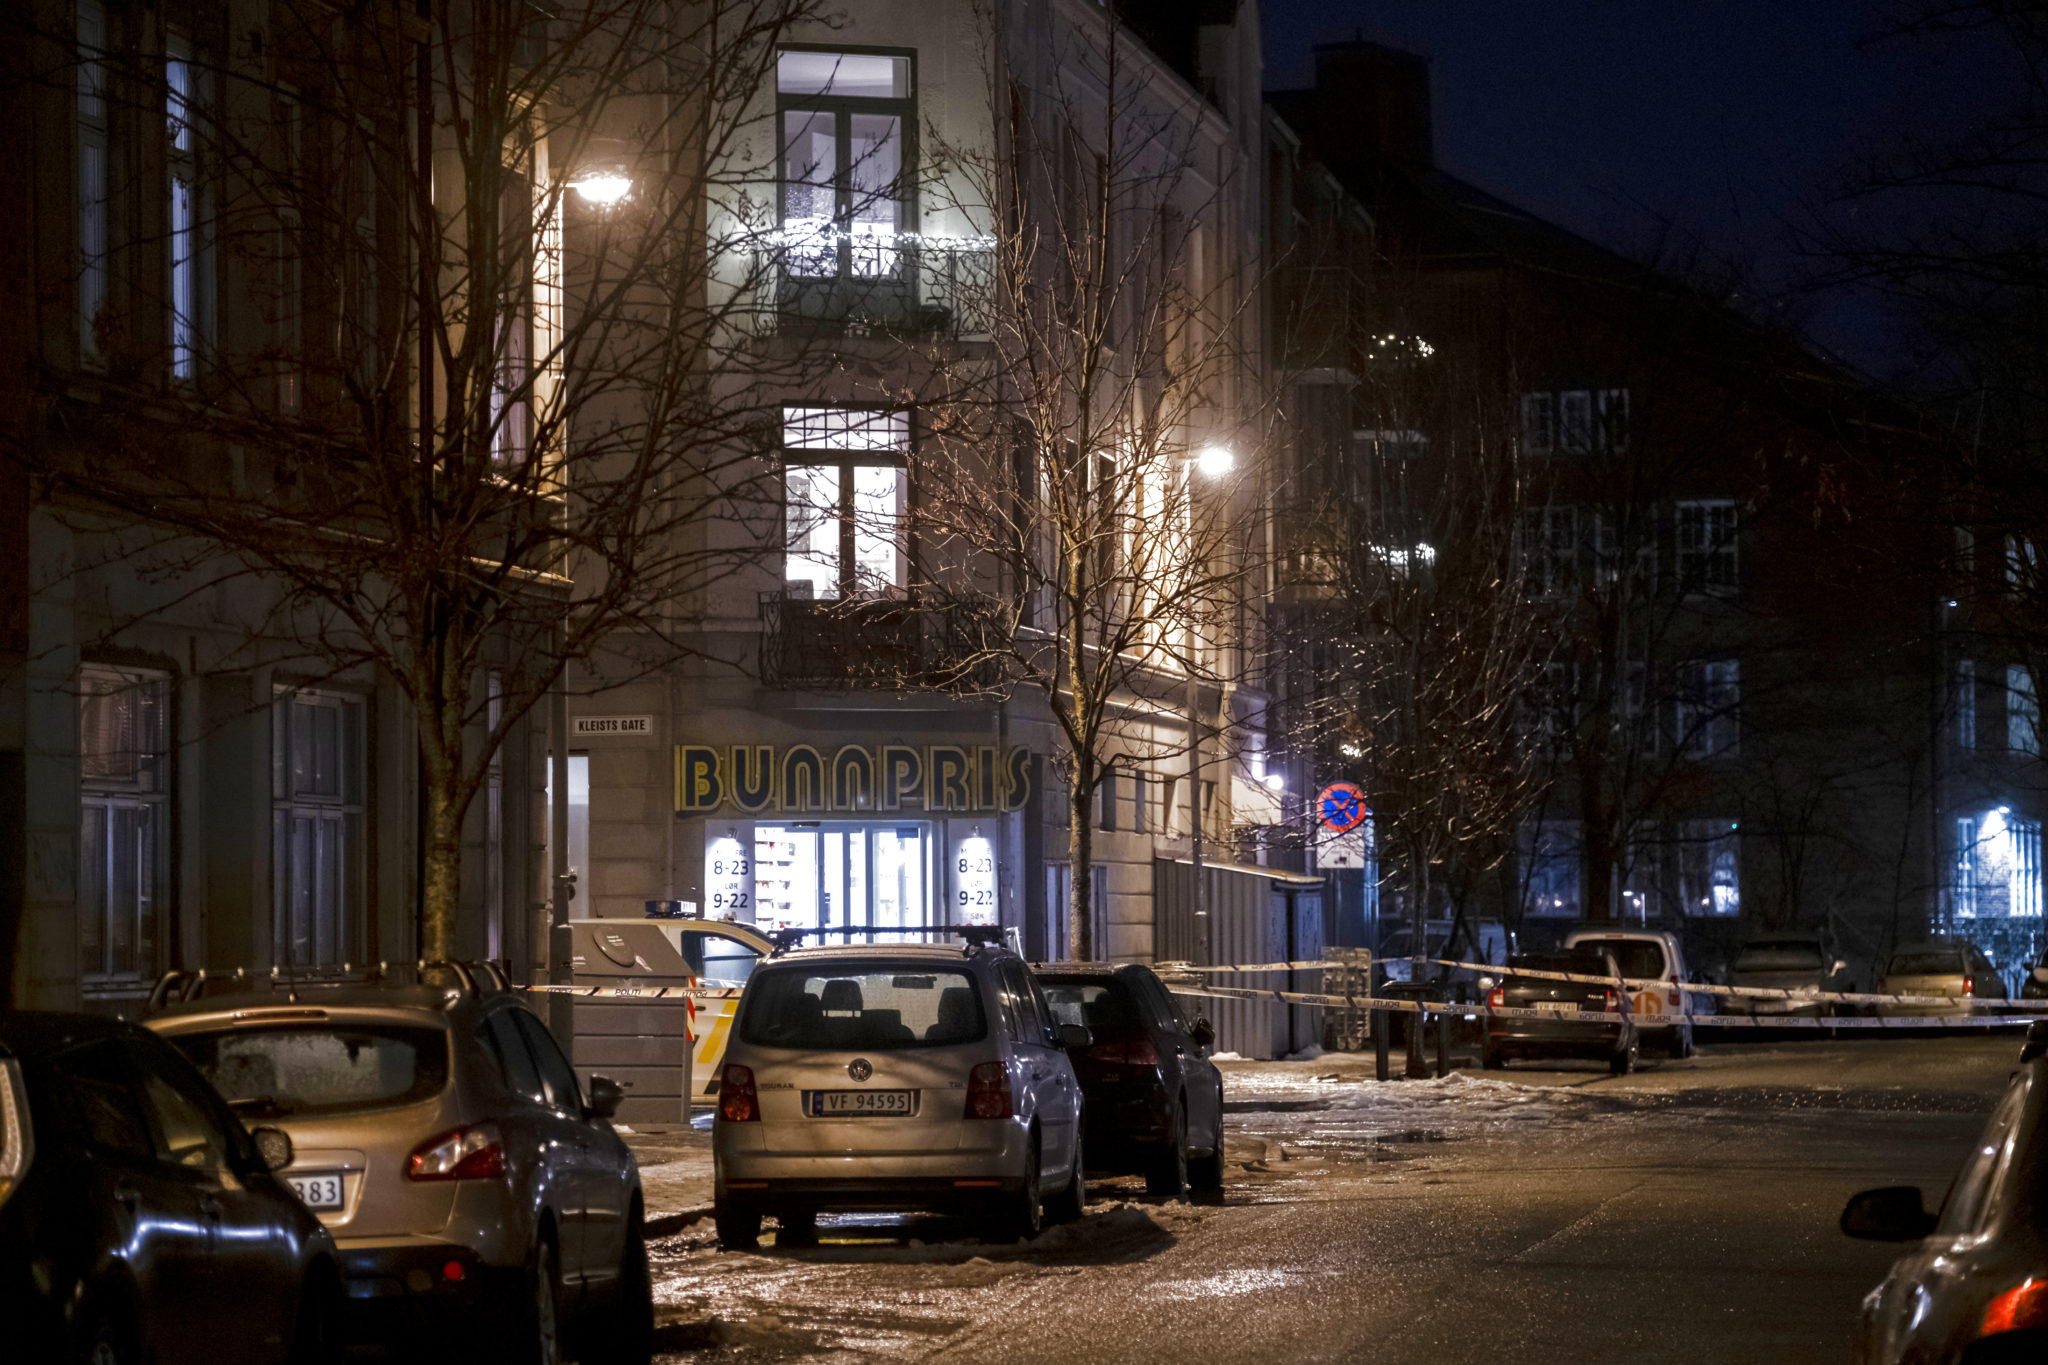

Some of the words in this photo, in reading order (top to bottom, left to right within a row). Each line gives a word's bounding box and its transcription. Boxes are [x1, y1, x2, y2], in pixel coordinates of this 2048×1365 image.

[578, 719, 618, 732] KLEISTS
[620, 718, 646, 731] GATE
[674, 743, 1033, 813] BUNNPRIS
[713, 860, 749, 876] 8-23
[713, 893, 749, 909] 9-22
[959, 890, 993, 906] 9-22
[615, 988, 641, 997] POLITI
[829, 1095, 848, 1109] VF
[856, 1094, 905, 1109] 94595
